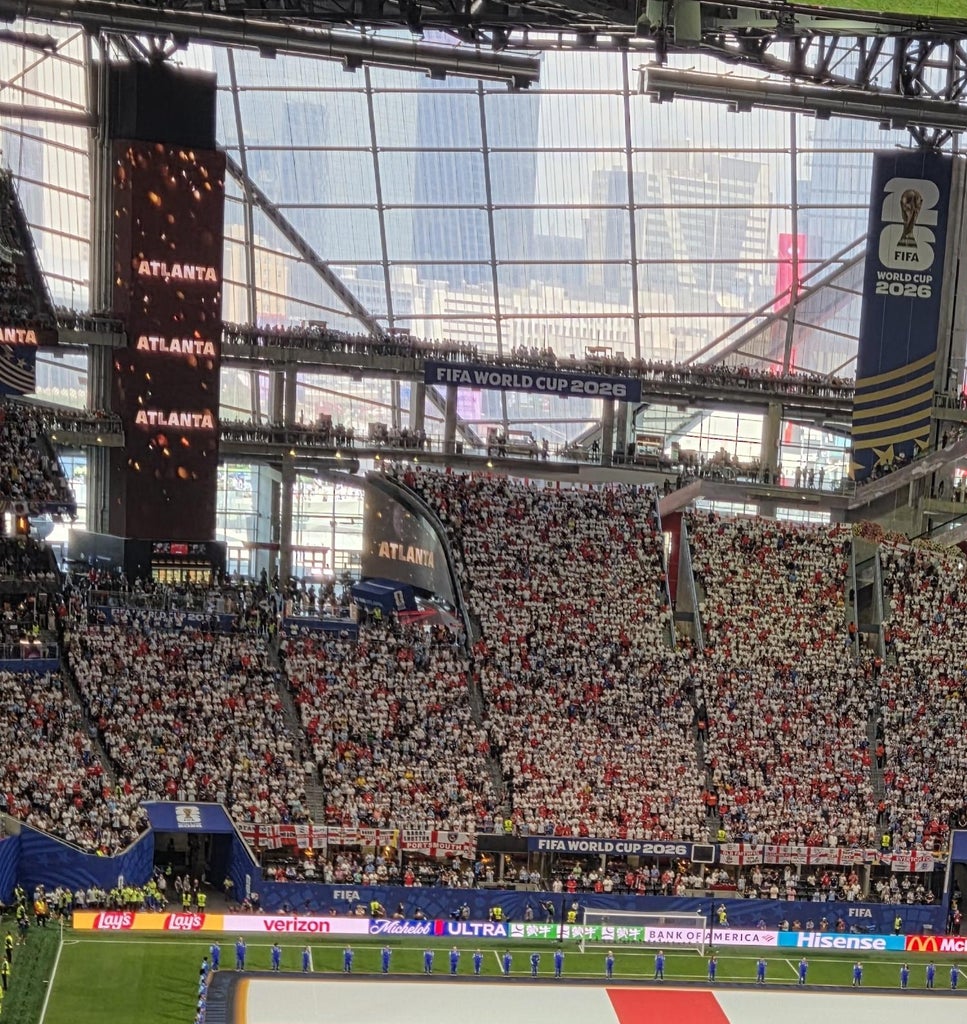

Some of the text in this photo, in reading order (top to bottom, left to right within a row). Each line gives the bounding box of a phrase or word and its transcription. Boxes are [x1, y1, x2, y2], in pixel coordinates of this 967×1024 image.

[894, 251, 919, 262] FIFA
[138, 260, 217, 282] ATLANTA
[877, 271, 933, 283] WORLD CUP
[875, 281, 932, 298] 2026
[136, 335, 216, 356] ATLANTA
[437, 368, 627, 397] FIFA WORLD CUP 2026
[135, 410, 214, 428] ATLANTA
[379, 541, 434, 569] ATLANTA
[406, 841, 462, 850] PORTSMOUTH
[538, 839, 687, 855] FIFA WORLD CUP 2026
[333, 890, 360, 900] FIFA
[849, 908, 872, 917] FIFA
[98, 913, 131, 930] Lay's
[169, 913, 201, 930] Lay's
[263, 917, 330, 932] verizon
[369, 919, 507, 937] Michelob ULTRA
[649, 930, 759, 942] BANK OF AMERICA
[797, 935, 887, 950] Hisense
